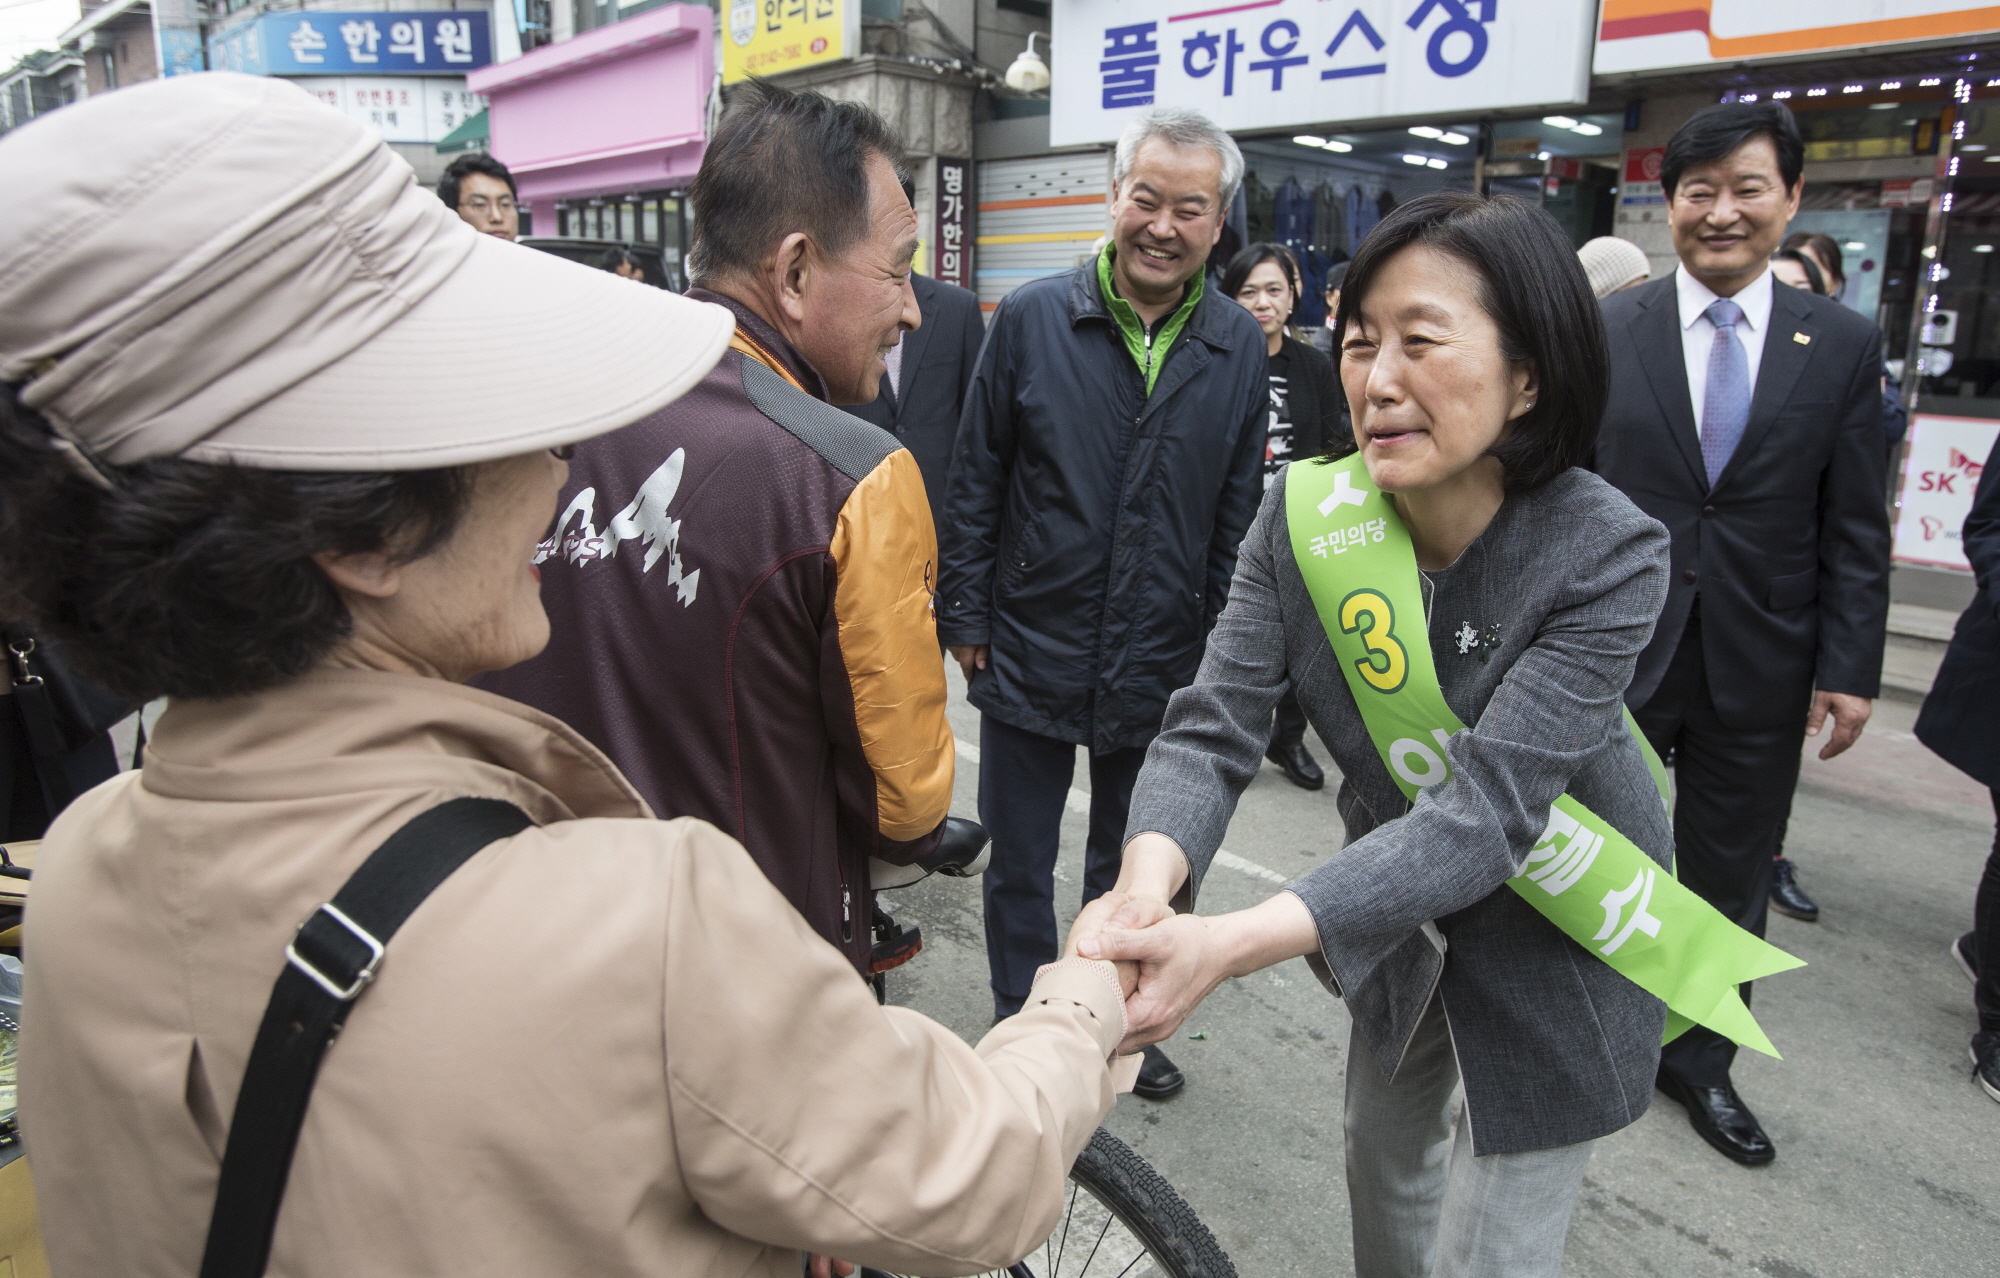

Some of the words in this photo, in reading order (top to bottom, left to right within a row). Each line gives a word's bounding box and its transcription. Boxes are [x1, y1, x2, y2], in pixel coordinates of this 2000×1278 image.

[288, 19, 474, 64] 손한의원
[941, 166, 964, 286] 명가한의
[1918, 471, 1957, 494] SK
[1309, 517, 1387, 559] 국민의당
[1338, 587, 1410, 695] 3
